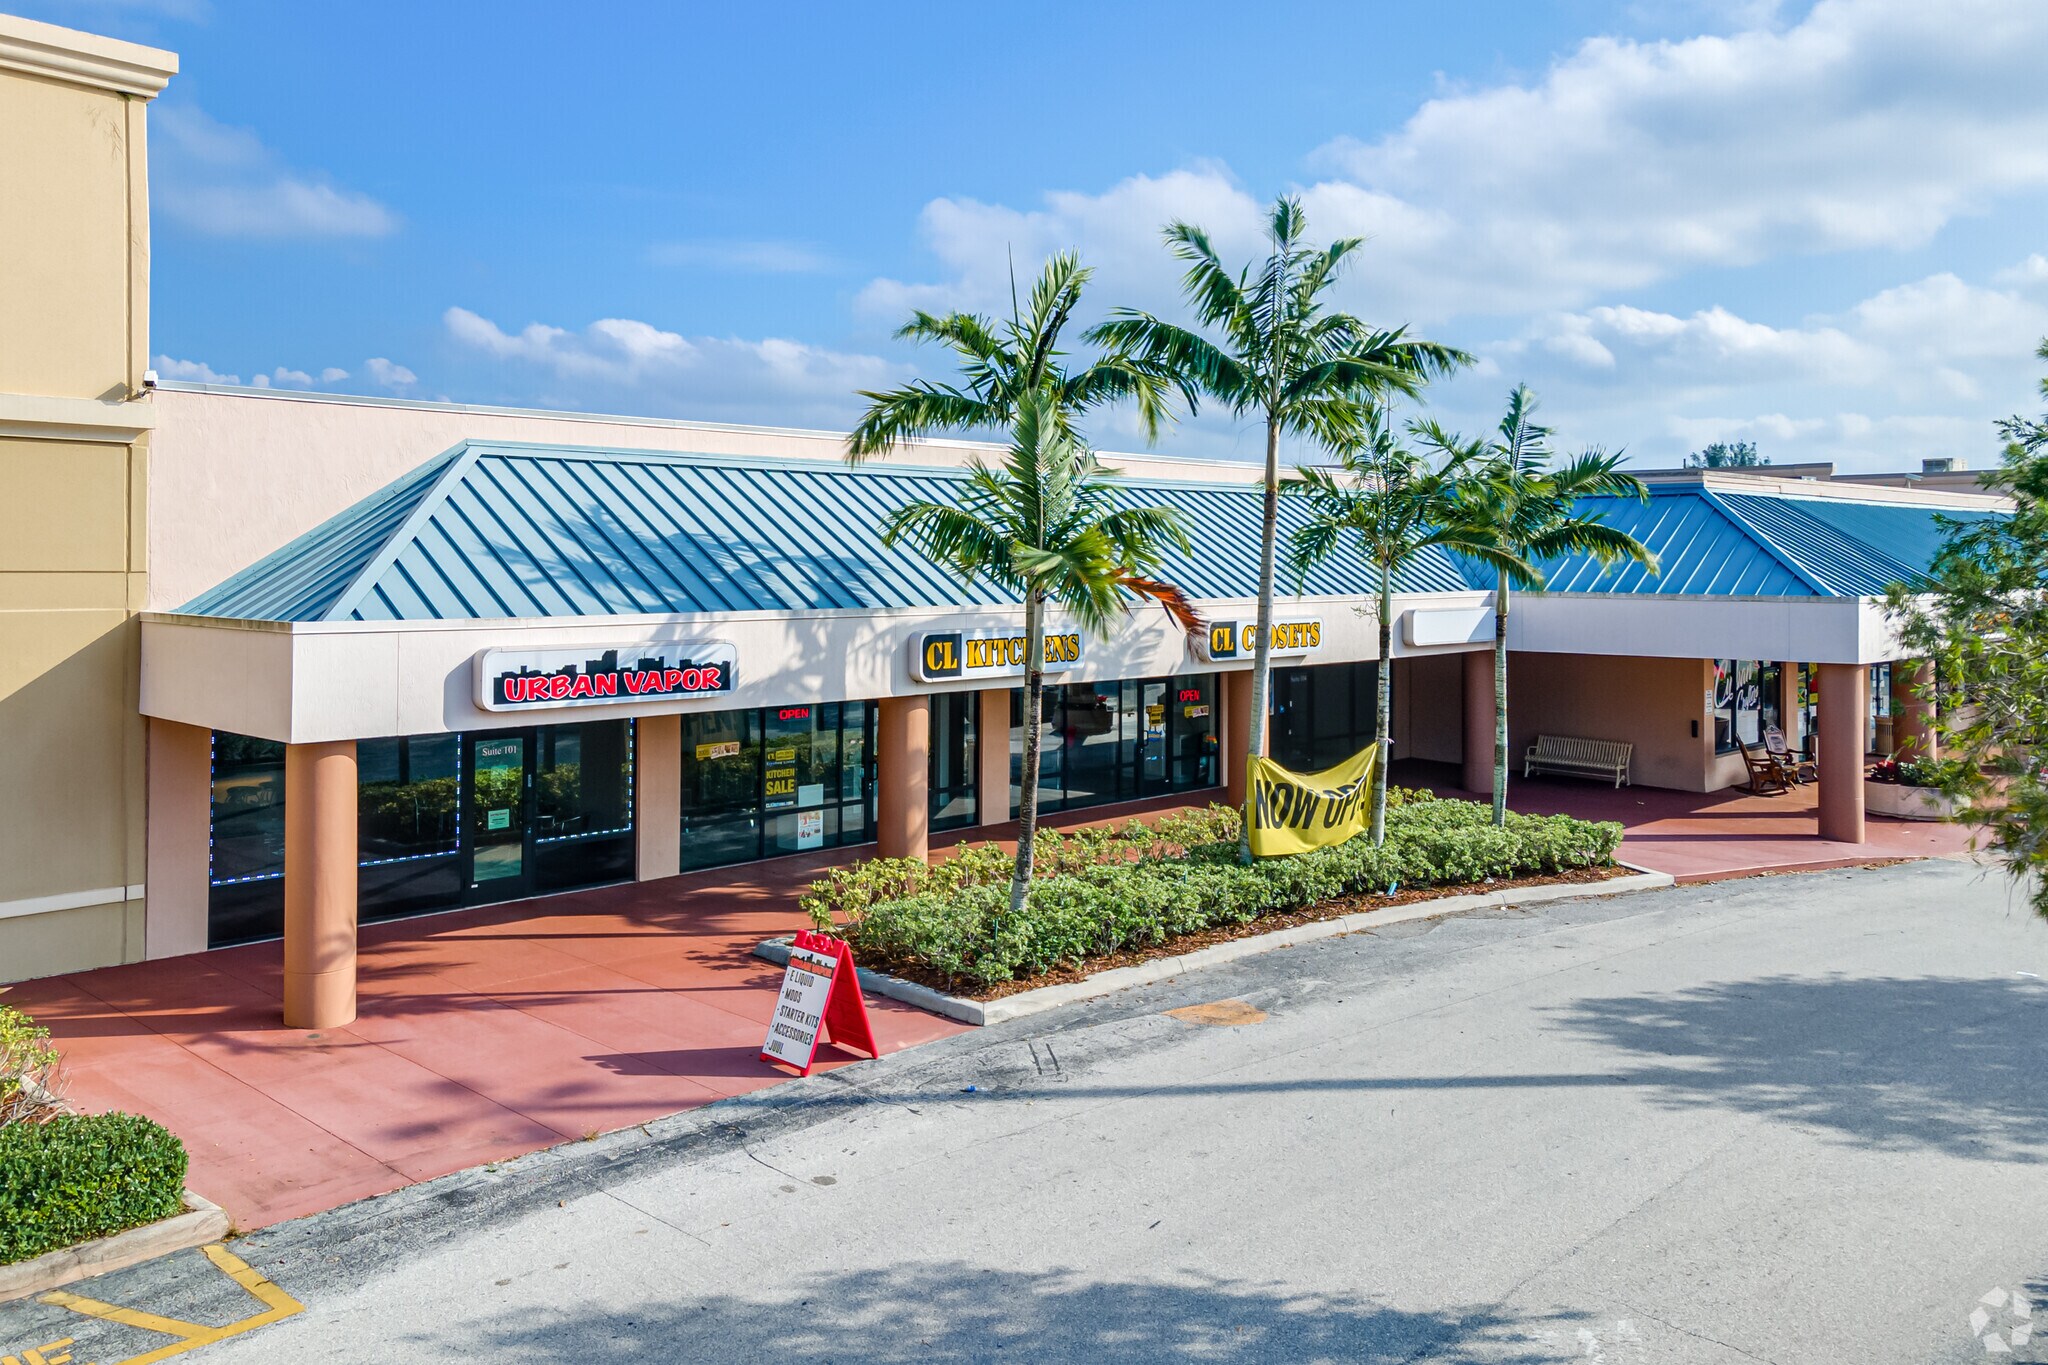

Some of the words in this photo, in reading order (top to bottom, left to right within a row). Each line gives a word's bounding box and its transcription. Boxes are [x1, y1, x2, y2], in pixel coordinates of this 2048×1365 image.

[1212, 628, 1234, 652] CL
[926, 641, 958, 671] CL
[966, 634, 1079, 668] KITCENS
[504, 673, 617, 701] URBAN
[624, 667, 721, 693] VAPOR
[1180, 690, 1199, 701] OPEN
[779, 708, 809, 720] OPEN
[482, 747, 502, 756] Suite
[504, 745, 517, 754] 101
[766, 768, 795, 779] KITCHEN
[766, 779, 795, 795] SALE
[1255, 779, 1321, 830] NOW
[789, 970, 795, 981] E
[784, 988, 802, 1003] MODS
[779, 1005, 805, 1023] STARTER
[804, 1015, 820, 1028] KITS
[774, 1023, 813, 1045] ACCESSORIES
